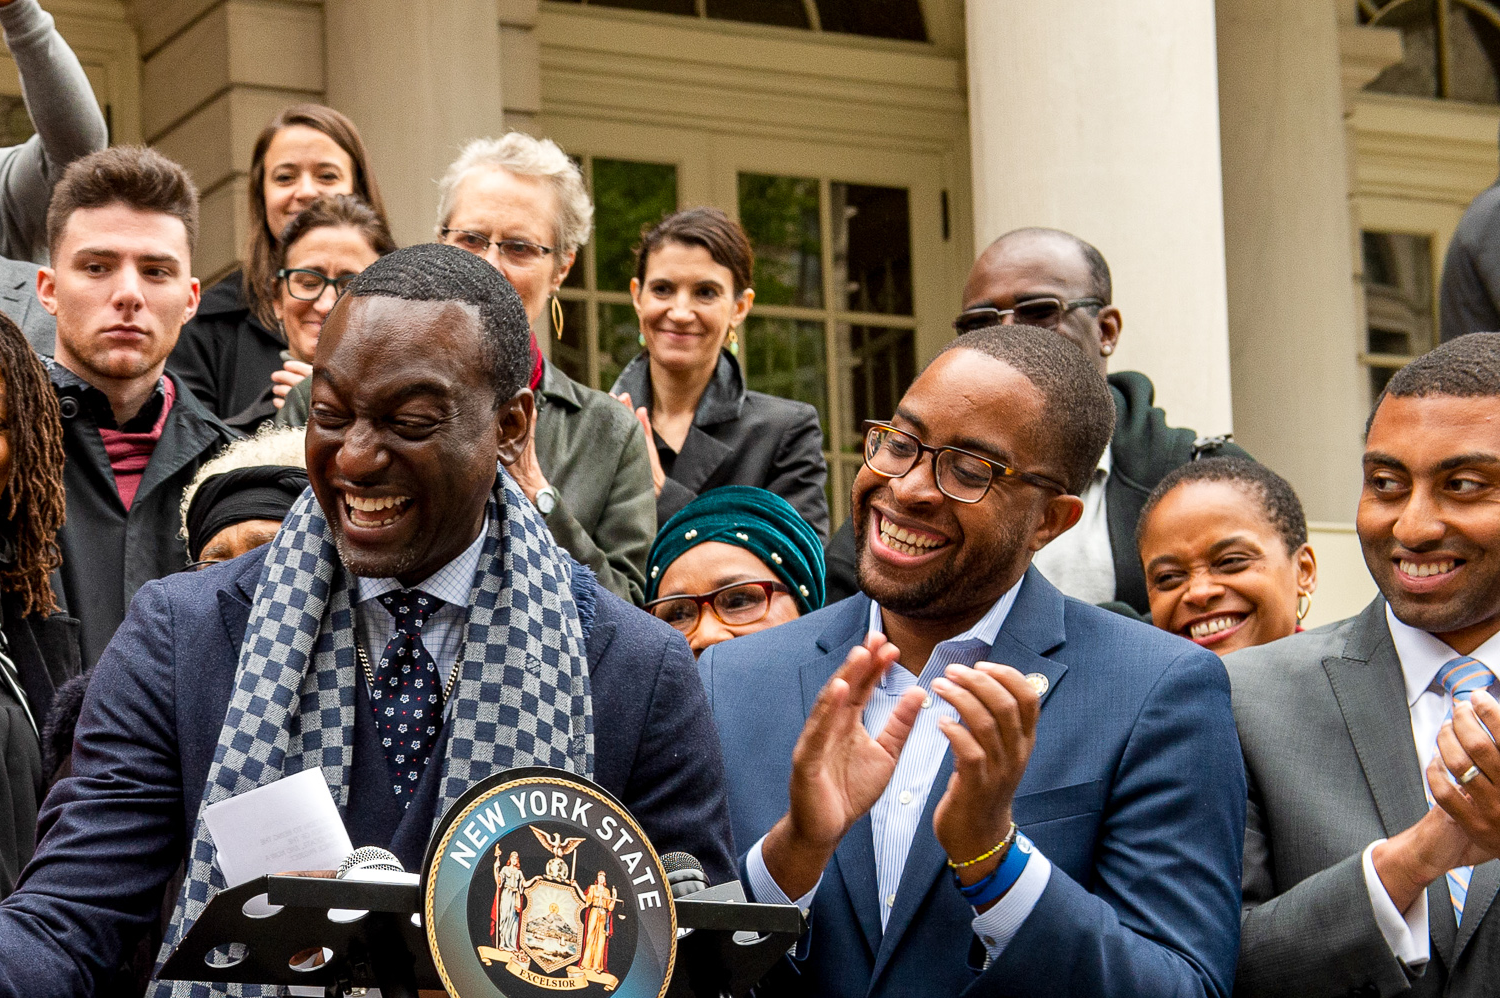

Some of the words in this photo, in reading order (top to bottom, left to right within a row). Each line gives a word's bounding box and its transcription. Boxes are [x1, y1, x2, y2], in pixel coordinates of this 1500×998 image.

[450, 801, 506, 869] NEW
[510, 791, 593, 827] YORK
[596, 816, 661, 910] STATE
[519, 969, 575, 988] EXCELSIOR
